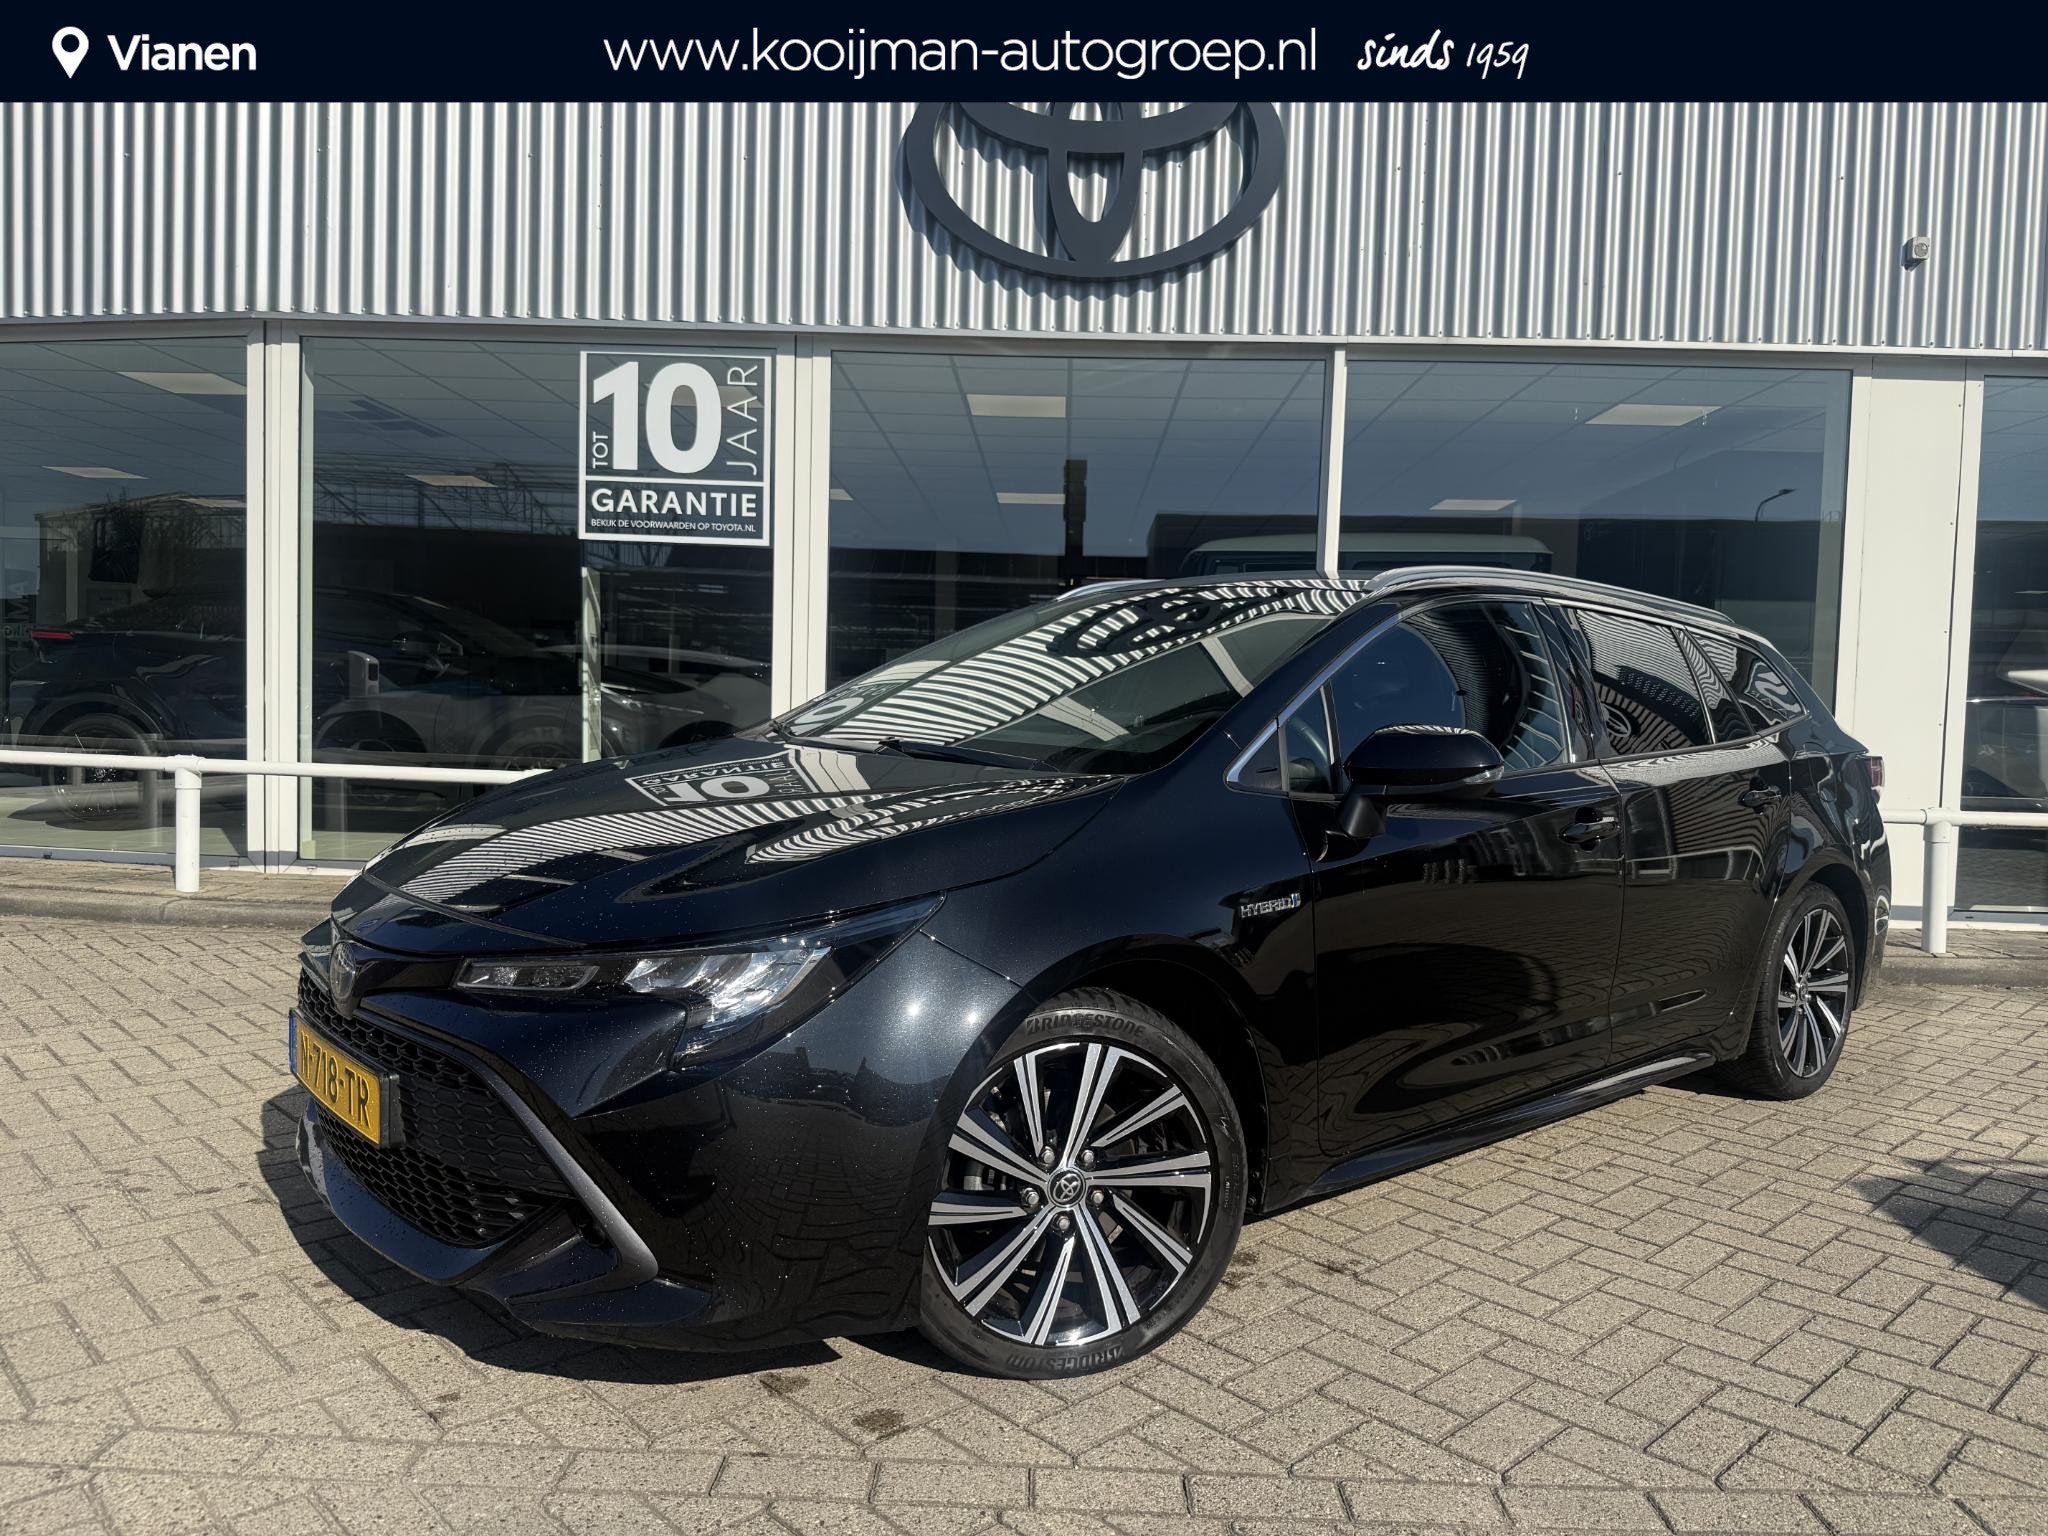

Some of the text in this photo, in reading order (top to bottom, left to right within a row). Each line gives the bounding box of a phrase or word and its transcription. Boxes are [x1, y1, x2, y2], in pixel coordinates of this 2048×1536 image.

[593, 361, 722, 474] 10
[726, 365, 758, 476] JAAR
[593, 431, 609, 469] TOT
[591, 488, 757, 518] GARANTIE
[591, 518, 756, 533] BEKIJK DE VOORWAARDEN OP TOYOTA.NL
[1241, 897, 1293, 918] HYBRID
[1025, 1013, 1146, 1038] BRIDGESTONE
[301, 1030, 371, 1129] N-718-TR
